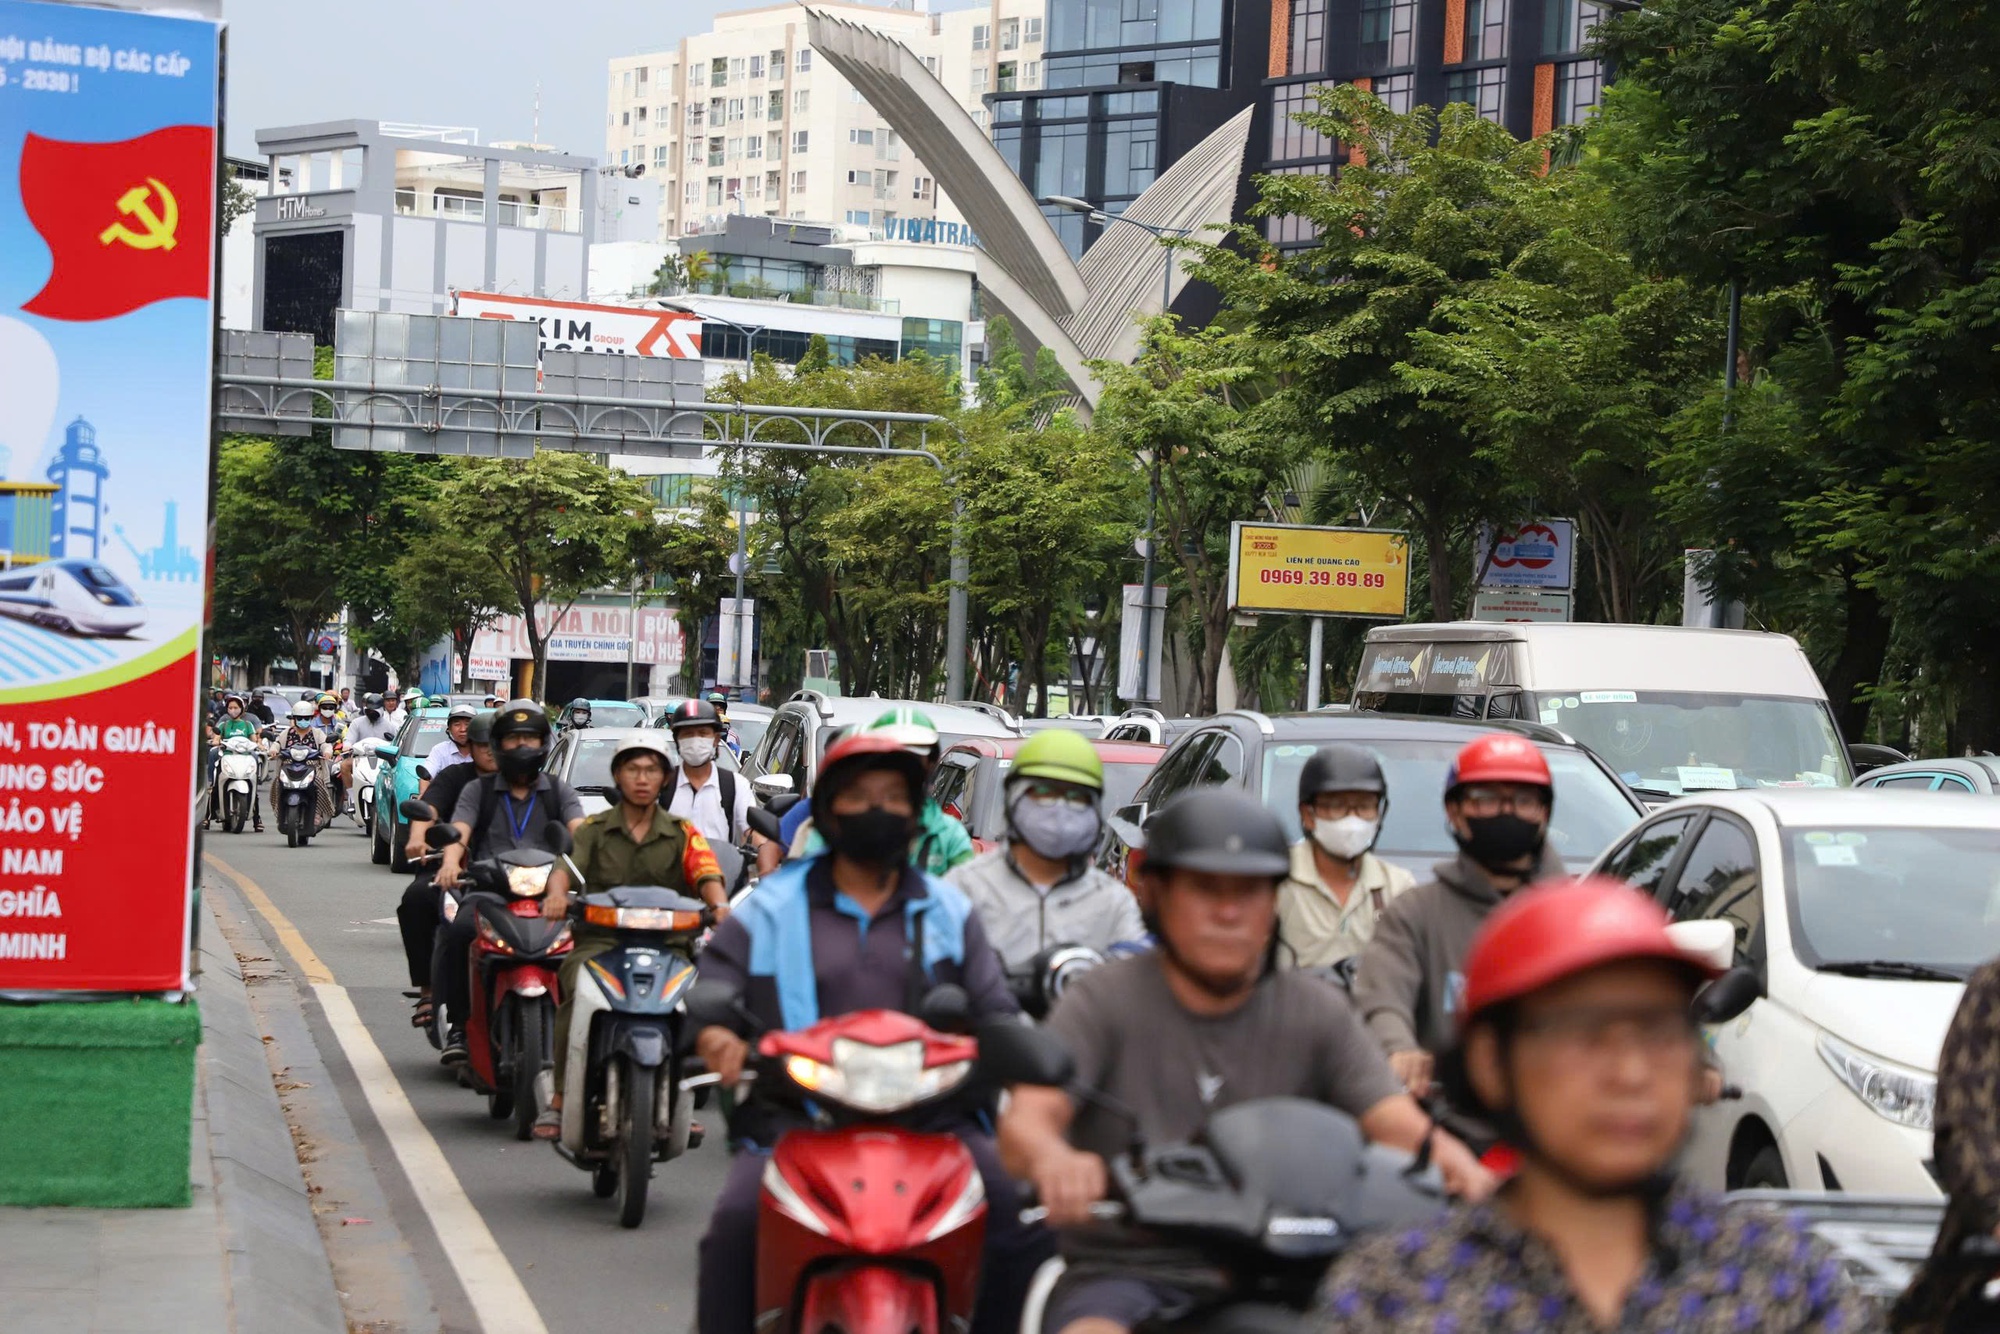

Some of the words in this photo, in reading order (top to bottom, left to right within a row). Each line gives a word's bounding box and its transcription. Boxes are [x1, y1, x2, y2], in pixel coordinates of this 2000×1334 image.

[84, 44, 111, 72] BỘ
[114, 48, 151, 73] CÁC
[154, 51, 191, 77] CẤP
[277, 196, 306, 219] HTM
[529, 316, 591, 341] KIM
[594, 335, 625, 346] GROUP
[1260, 568, 1385, 588] 0969.39.89.89
[644, 612, 680, 635] BÚN
[550, 639, 563, 649] GIA
[658, 637, 684, 661] HUẾ
[27, 716, 98, 750] TOÀN
[103, 720, 176, 754] QUÂN
[51, 758, 104, 793] SỨC
[51, 801, 83, 840] VỆ
[2, 848, 63, 875] NAM
[0, 884, 62, 918] GHĨA
[0, 932, 66, 960] MINH
